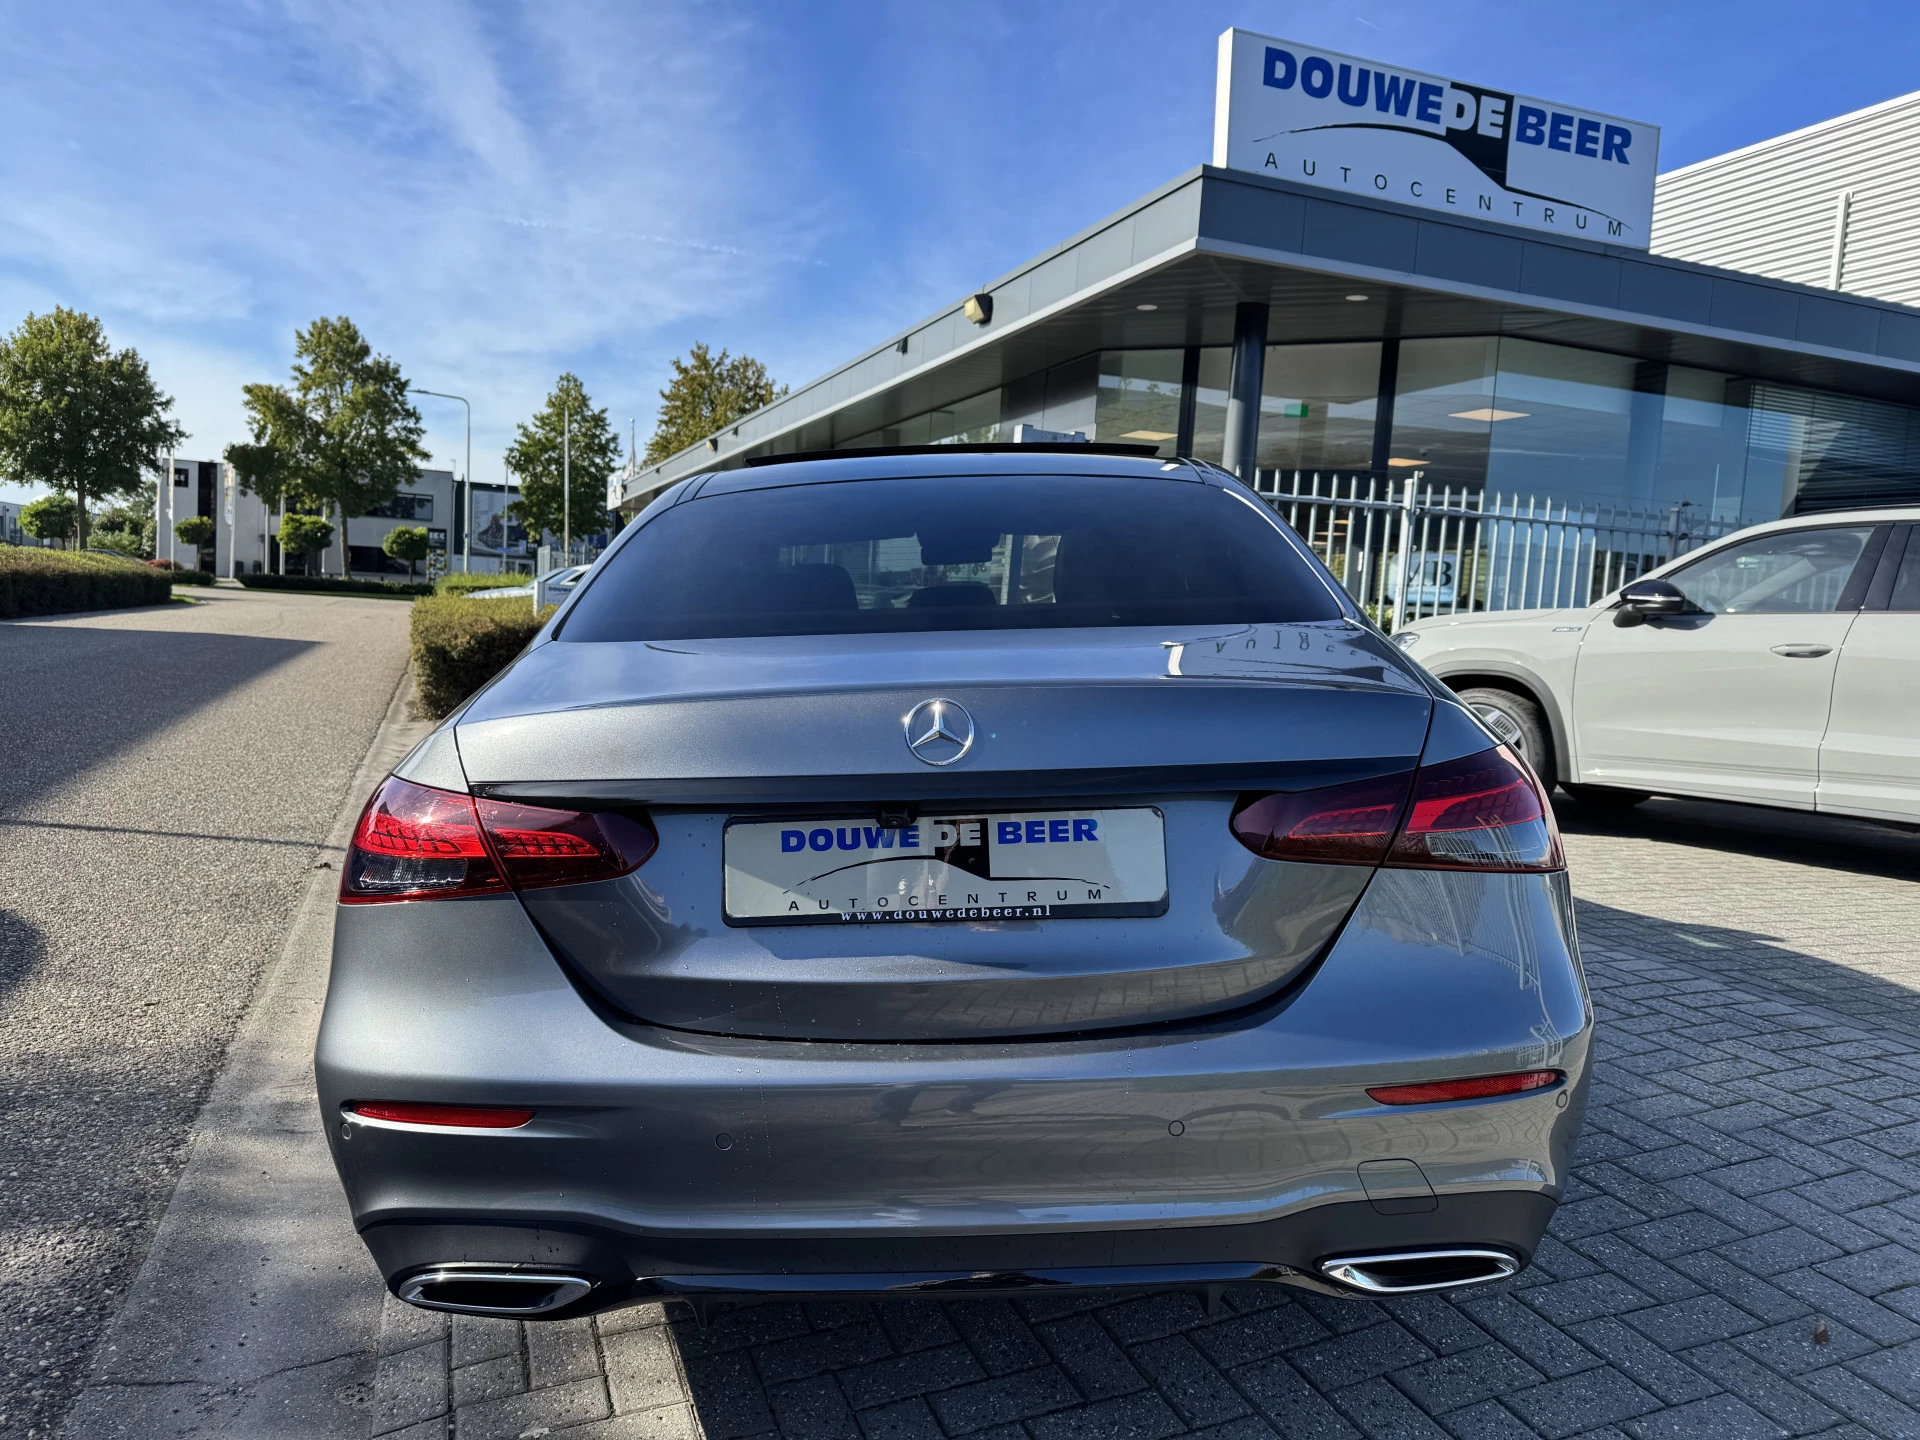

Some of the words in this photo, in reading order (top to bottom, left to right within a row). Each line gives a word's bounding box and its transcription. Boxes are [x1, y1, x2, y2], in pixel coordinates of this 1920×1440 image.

[1263, 46, 1444, 125] DOUWE
[1445, 88, 1506, 139] DE
[1515, 104, 1632, 165] BEER
[1264, 152, 1622, 237] AUTOCENTRUM
[780, 824, 920, 853] DOUWE
[932, 822, 982, 849] DE
[997, 818, 1099, 845] BEER
[788, 889, 1102, 911] AUTOCENTRUM
[840, 904, 1051, 921] www.douwedebeer.nl
